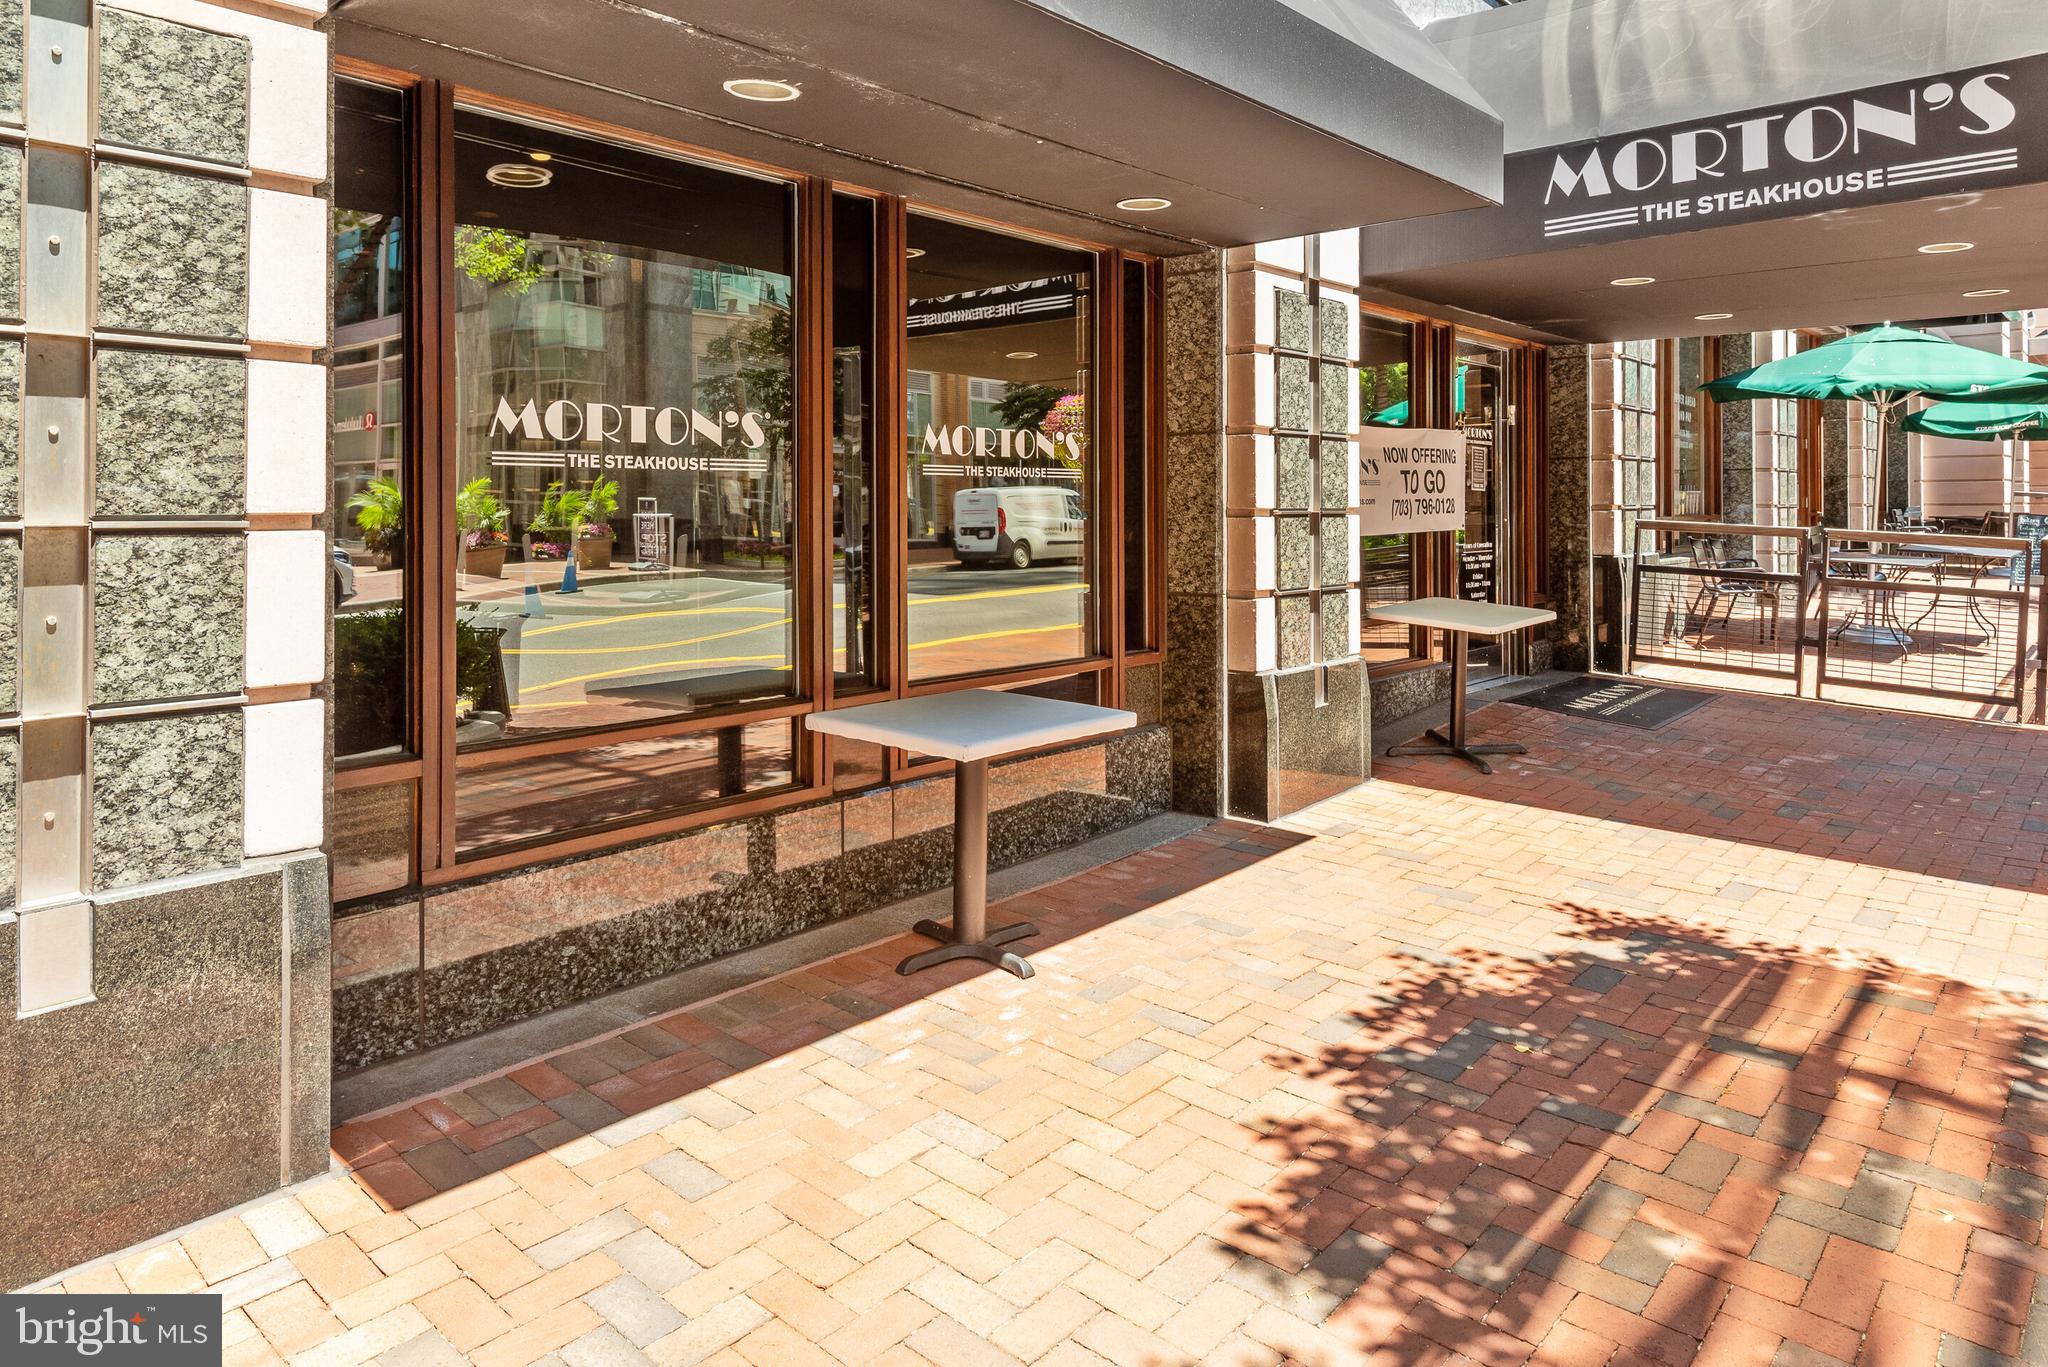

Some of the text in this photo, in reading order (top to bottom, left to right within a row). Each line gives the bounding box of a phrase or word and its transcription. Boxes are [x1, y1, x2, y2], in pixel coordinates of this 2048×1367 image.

[1544, 73, 2016, 205] MORTON'S
[1641, 168, 1884, 223] THE STEAKHOUSE
[489, 395, 766, 449] MORTON'S
[921, 423, 1080, 461] MORTON'S
[567, 453, 709, 472] THE STEAKHOUSE
[1383, 447, 1456, 464] NOW OFFERING
[965, 465, 1047, 479] THE STEAKHOUSE
[1400, 469, 1446, 494] TO GO
[1392, 498, 1456, 520] (703) 796-0128
